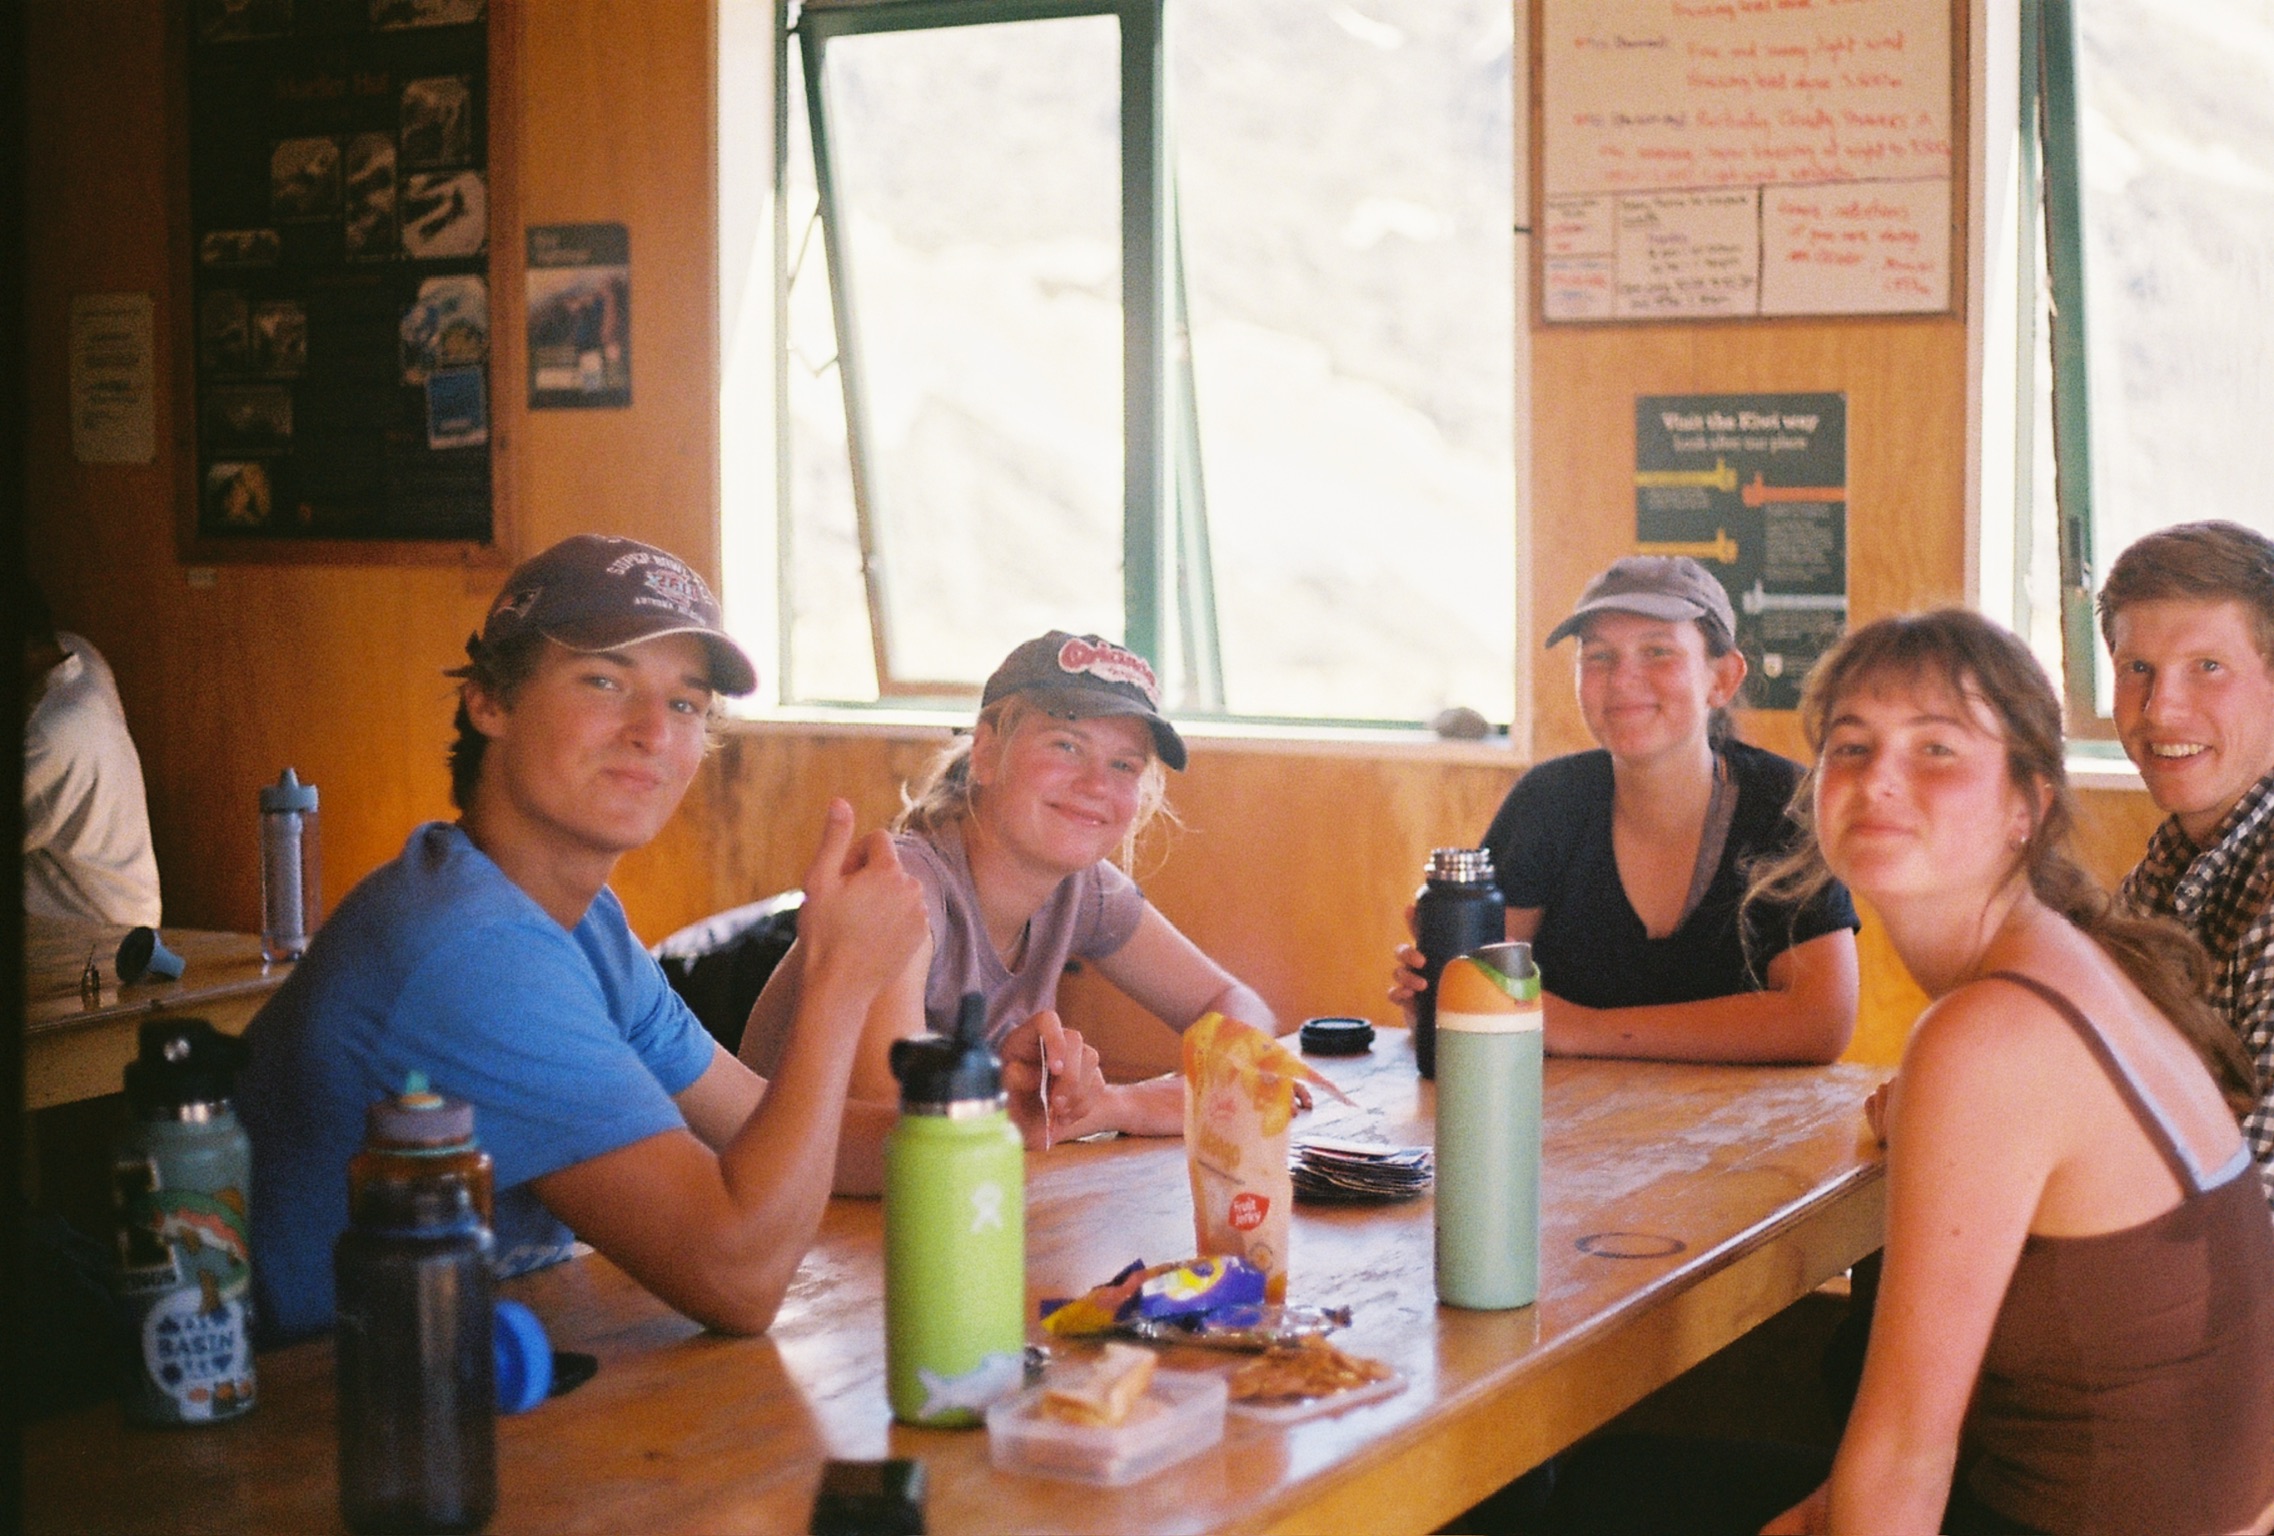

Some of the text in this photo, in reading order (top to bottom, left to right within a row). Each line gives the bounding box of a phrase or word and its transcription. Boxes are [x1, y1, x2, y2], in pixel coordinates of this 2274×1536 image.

[1661, 410, 1820, 435] Visit the Kiwi way
[606, 552, 650, 576] SUPER
[157, 1331, 235, 1359] BASIN
